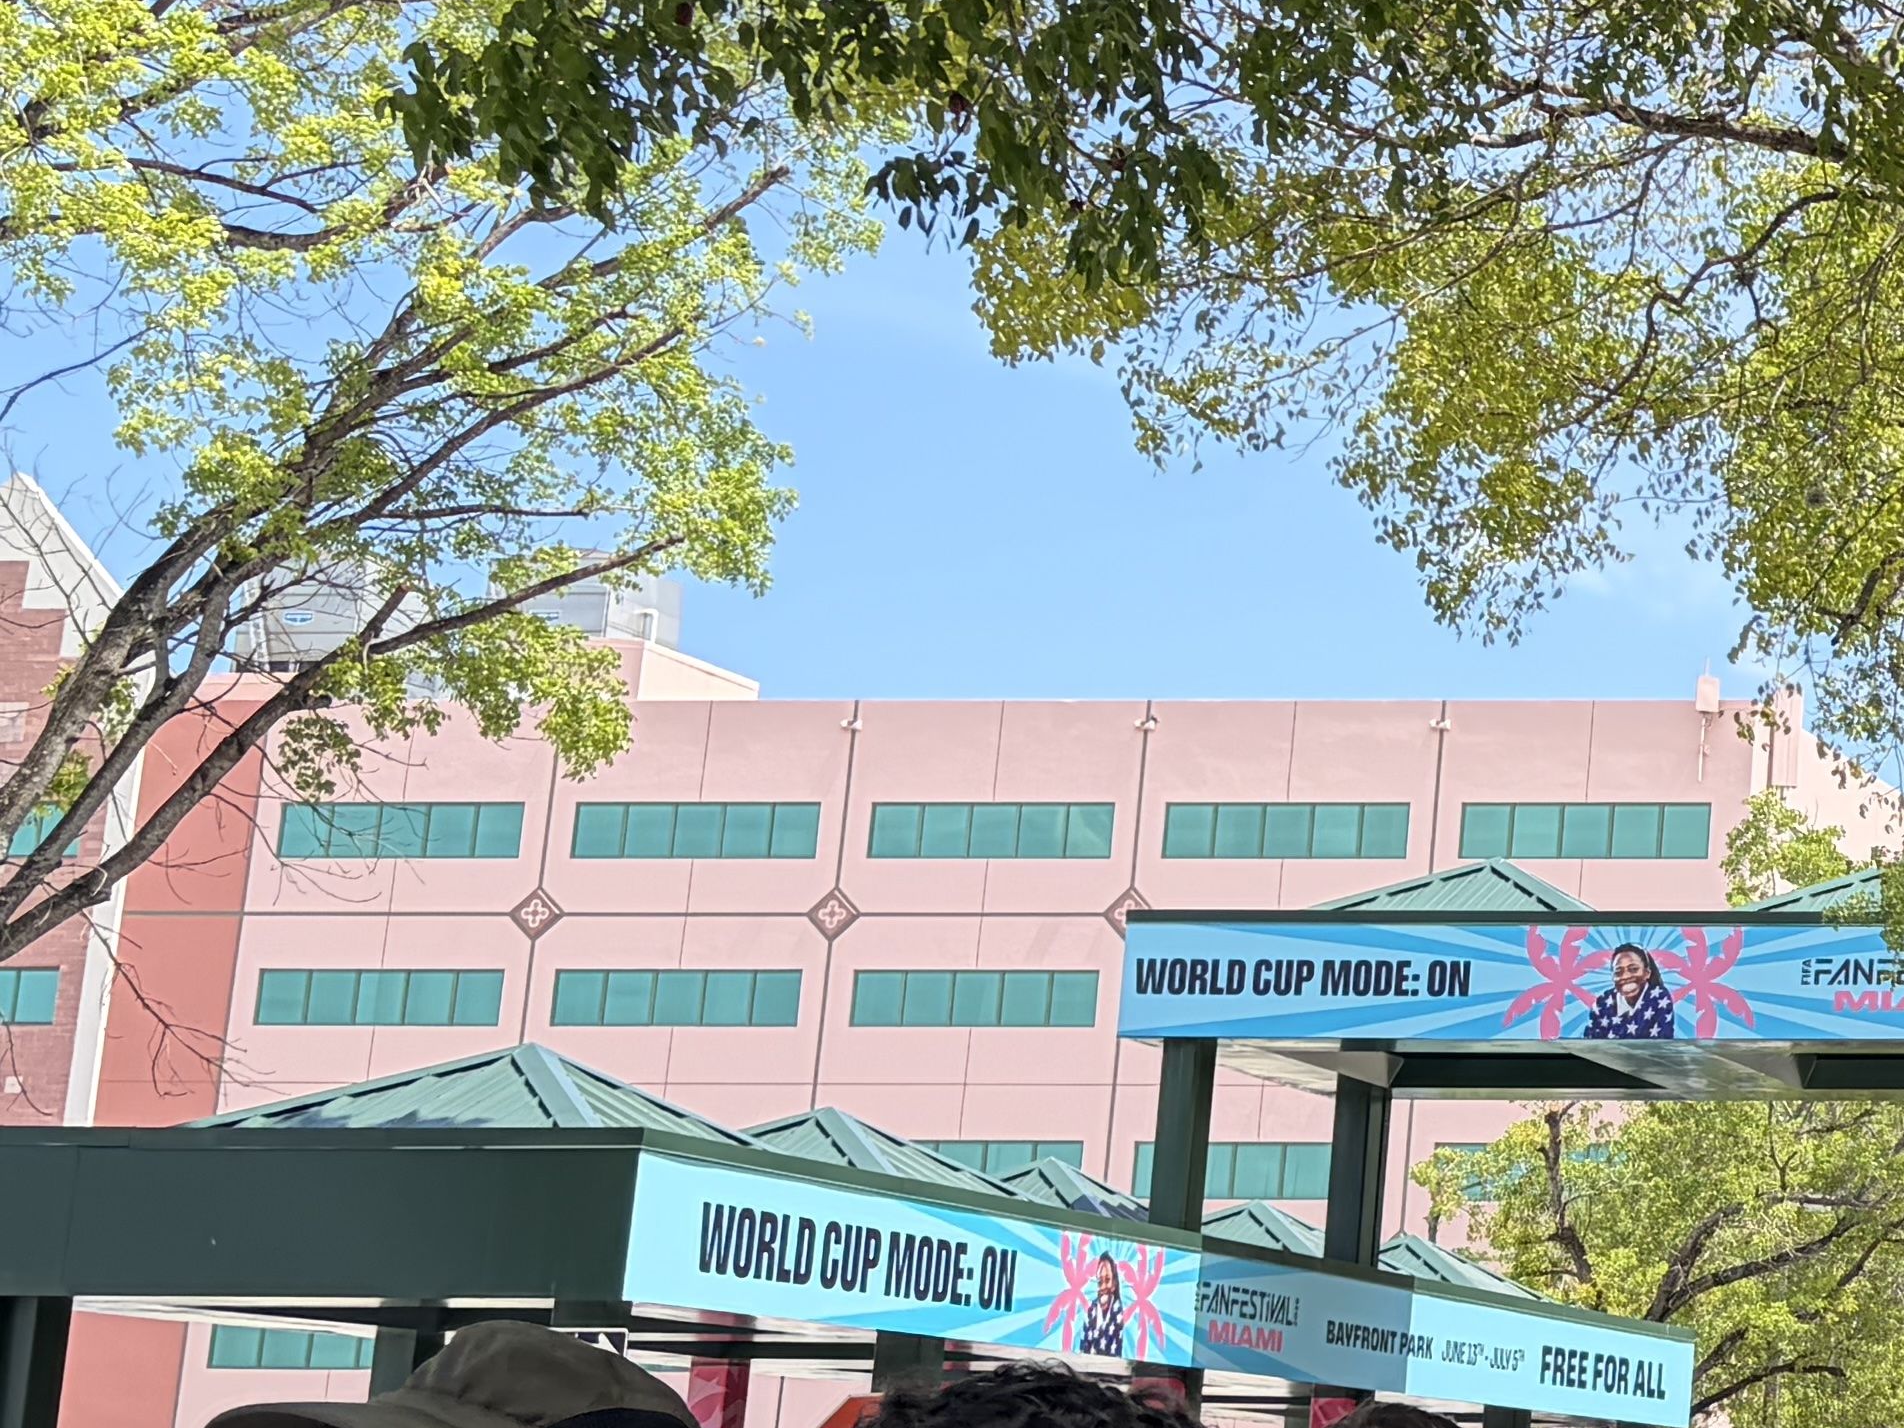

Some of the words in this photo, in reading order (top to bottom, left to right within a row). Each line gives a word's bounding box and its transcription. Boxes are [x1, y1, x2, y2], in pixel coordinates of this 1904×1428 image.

[1136, 958, 1247, 995] WORLD
[1252, 960, 1315, 997] CUP
[1320, 960, 1420, 997] MODE:
[1427, 960, 1472, 997] ON
[699, 1201, 817, 1285] WORLD
[820, 1221, 882, 1293] CUP
[884, 1231, 974, 1306] MODE:
[978, 1245, 1018, 1312] ON
[1209, 1319, 1283, 1352] MIAMI
[1326, 1320, 1397, 1355] BAYFRONT
[1399, 1332, 1434, 1359] PARK
[1539, 1345, 1589, 1390] FREE
[1591, 1354, 1629, 1395] FOR
[1633, 1360, 1666, 1400] ALL
